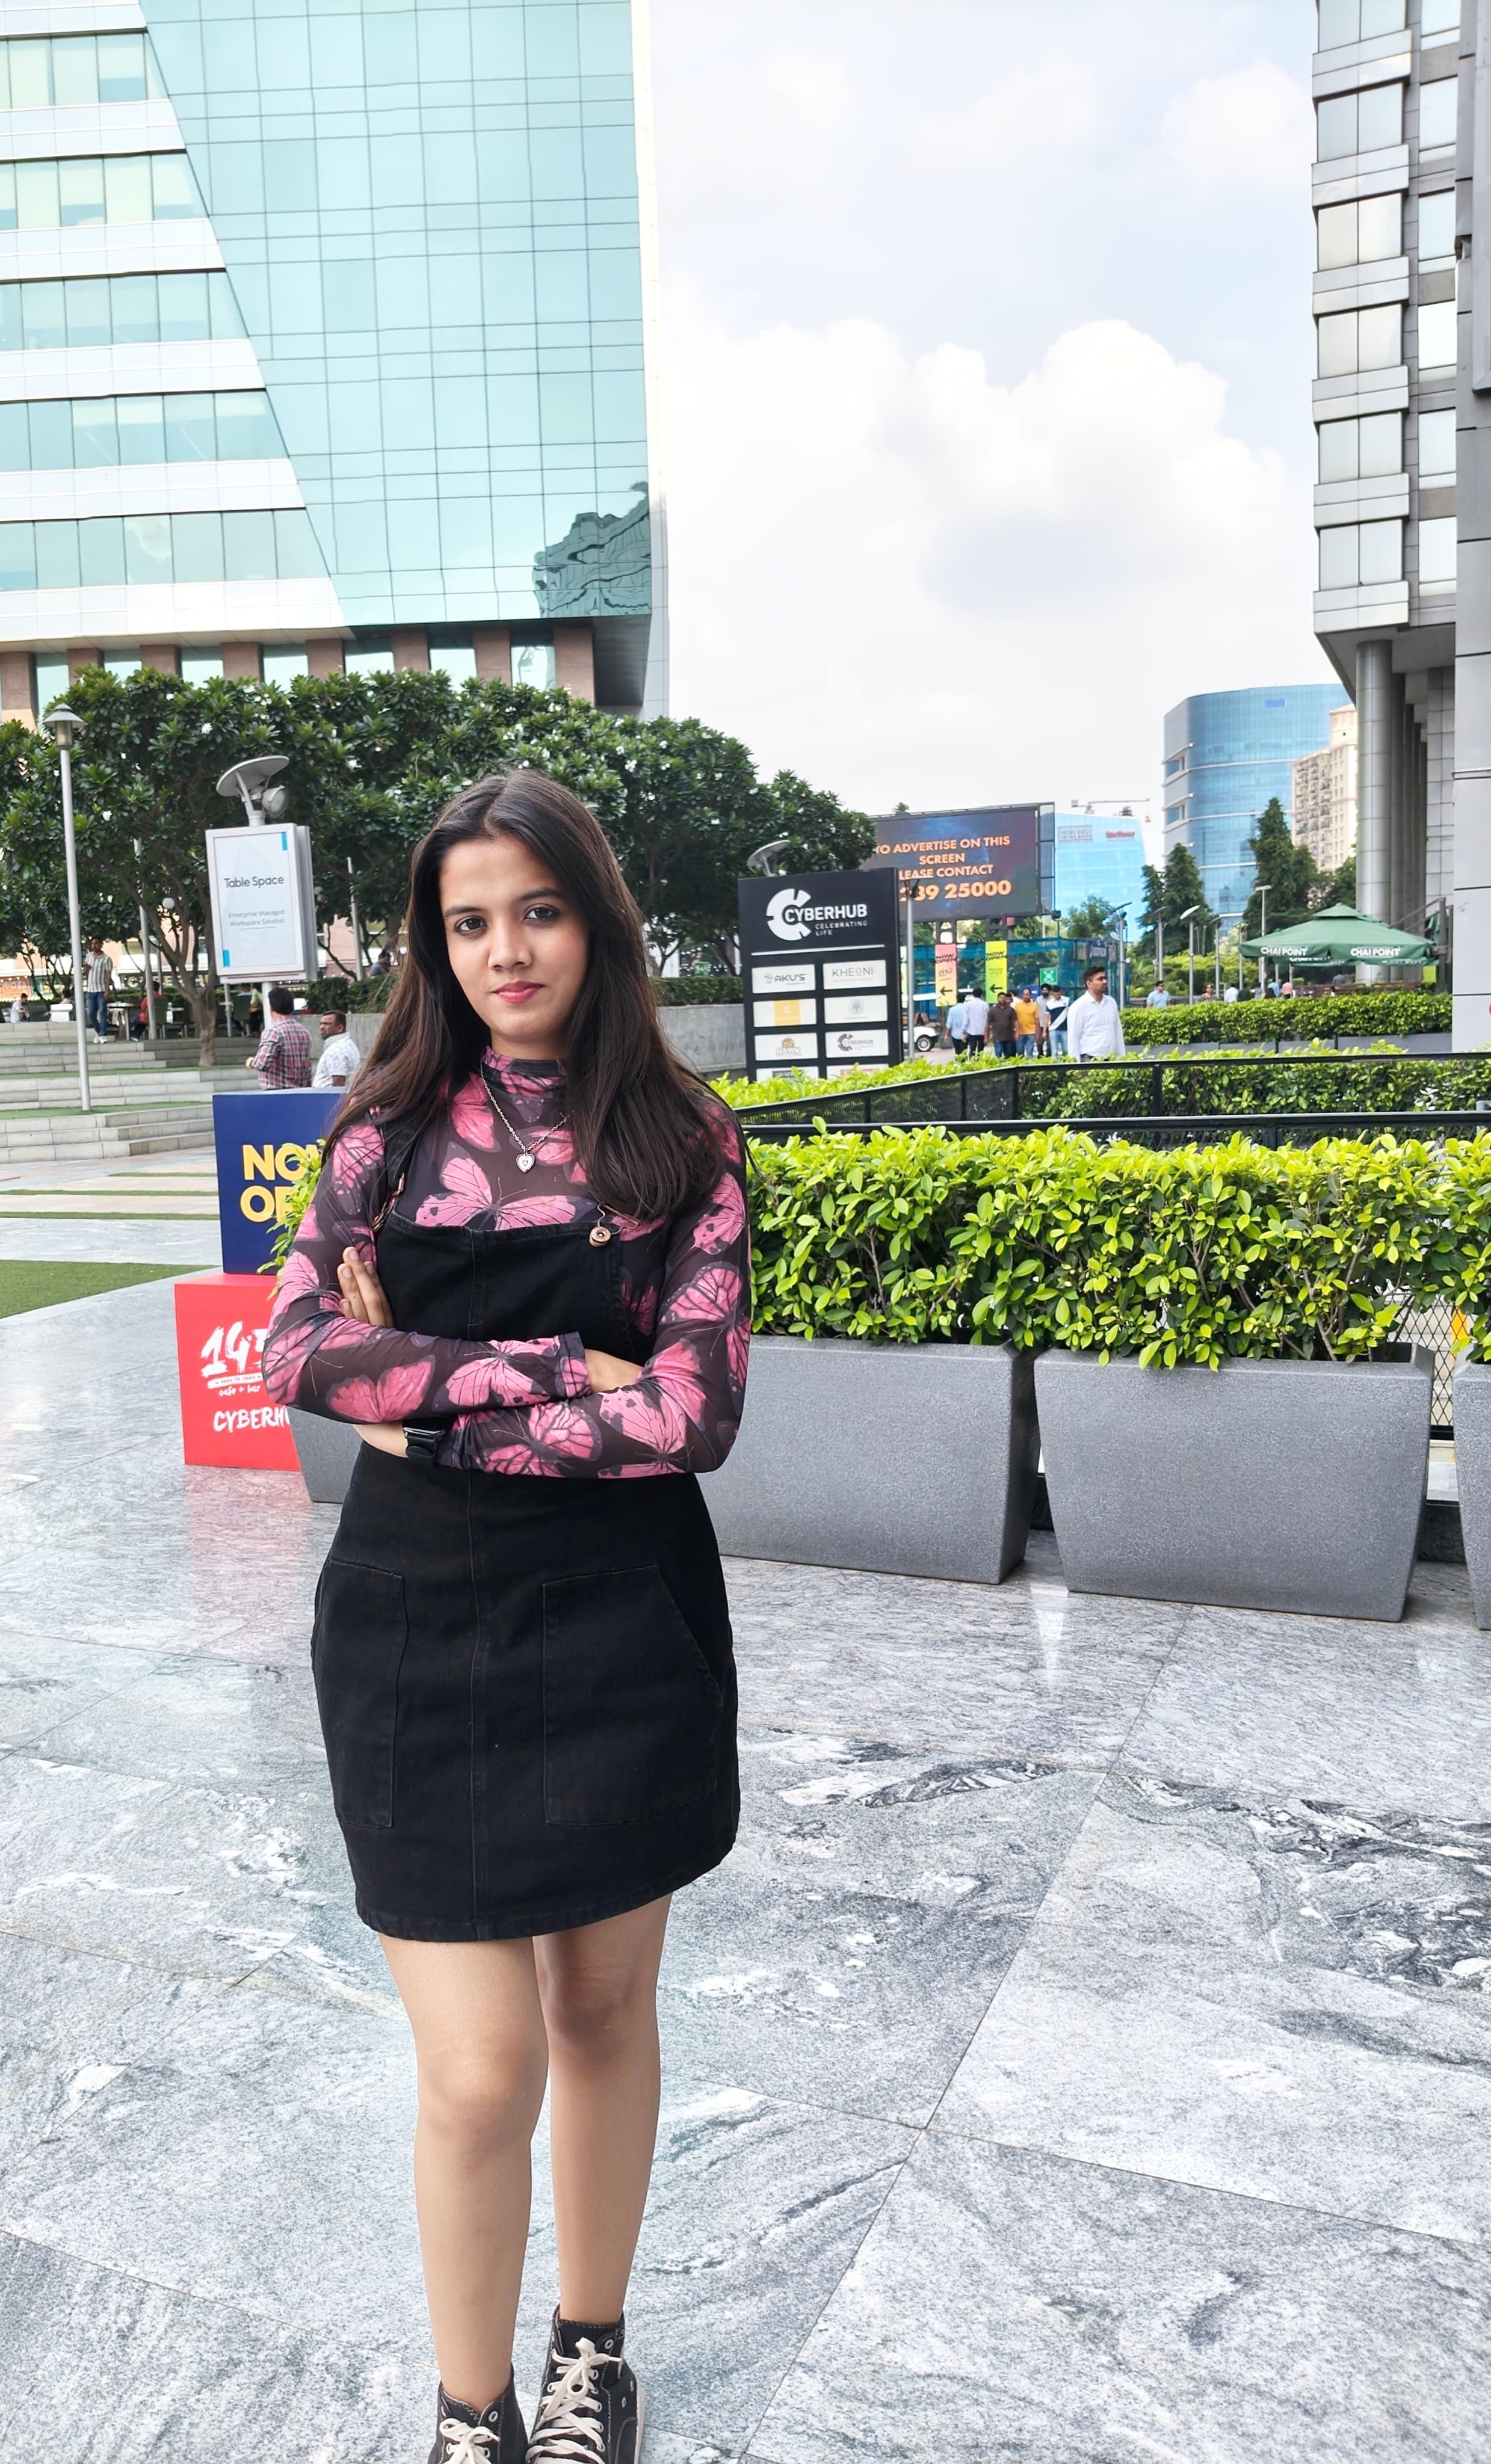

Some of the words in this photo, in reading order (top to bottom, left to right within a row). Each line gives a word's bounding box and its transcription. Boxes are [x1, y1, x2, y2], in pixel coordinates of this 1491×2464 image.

[893, 839, 957, 854] ADVERTISE
[960, 838, 980, 848] ON
[983, 836, 1010, 846] THIS
[919, 853, 965, 865] SCREEN
[899, 868, 933, 881] LEASE
[936, 864, 993, 878] CONTACT
[224, 877, 250, 889] Table
[252, 876, 284, 889] Space
[944, 879, 1011, 899] 25000
[785, 904, 868, 923] CYBERHUB
[815, 920, 868, 929] CELEBRATING
[1261, 946, 1281, 955] CHAI
[1282, 947, 1307, 956] POINT
[1350, 947, 1372, 956] CHAI
[1372, 947, 1400, 956] POINT
[247, 1384, 261, 1394] bar
[214, 1406, 291, 1433] CYBERH
